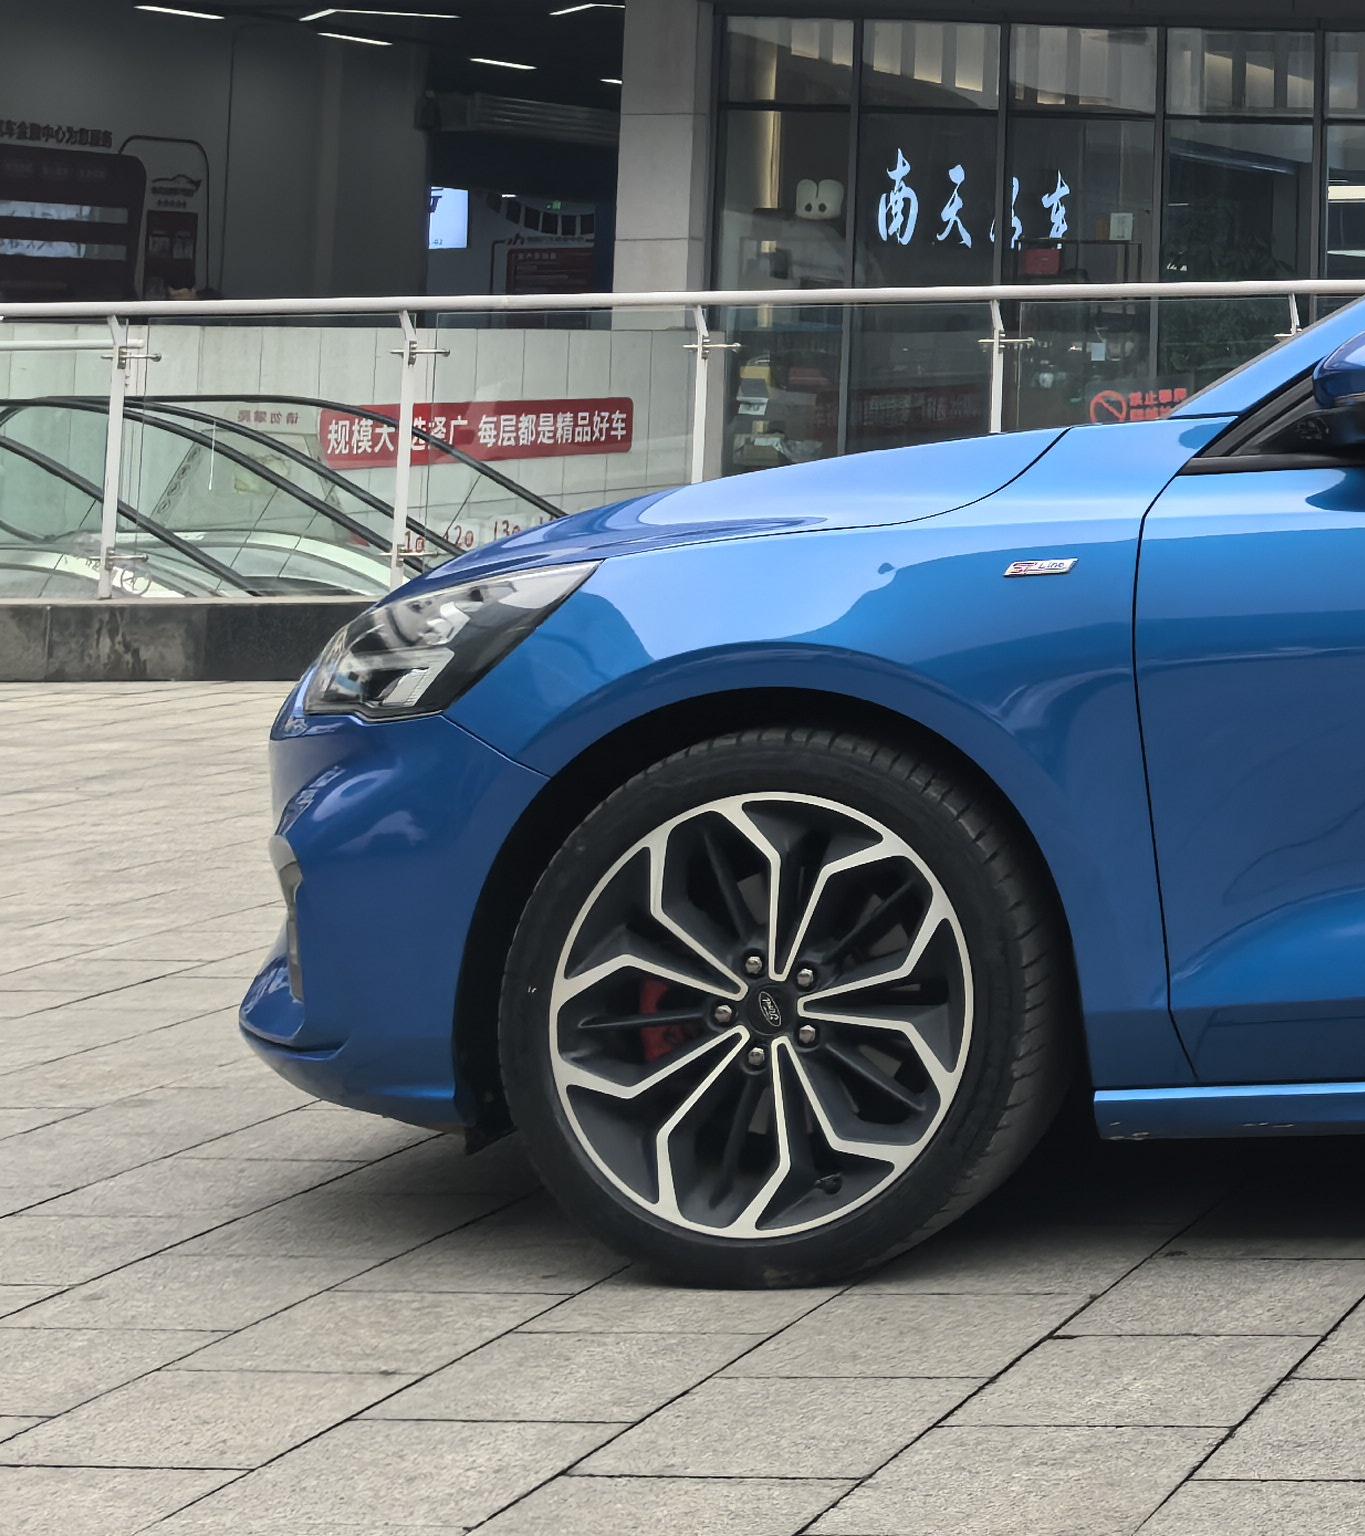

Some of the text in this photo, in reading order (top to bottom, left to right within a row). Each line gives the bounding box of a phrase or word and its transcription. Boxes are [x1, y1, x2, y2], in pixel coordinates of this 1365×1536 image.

[477, 409, 627, 448] 每层都是精品好车
